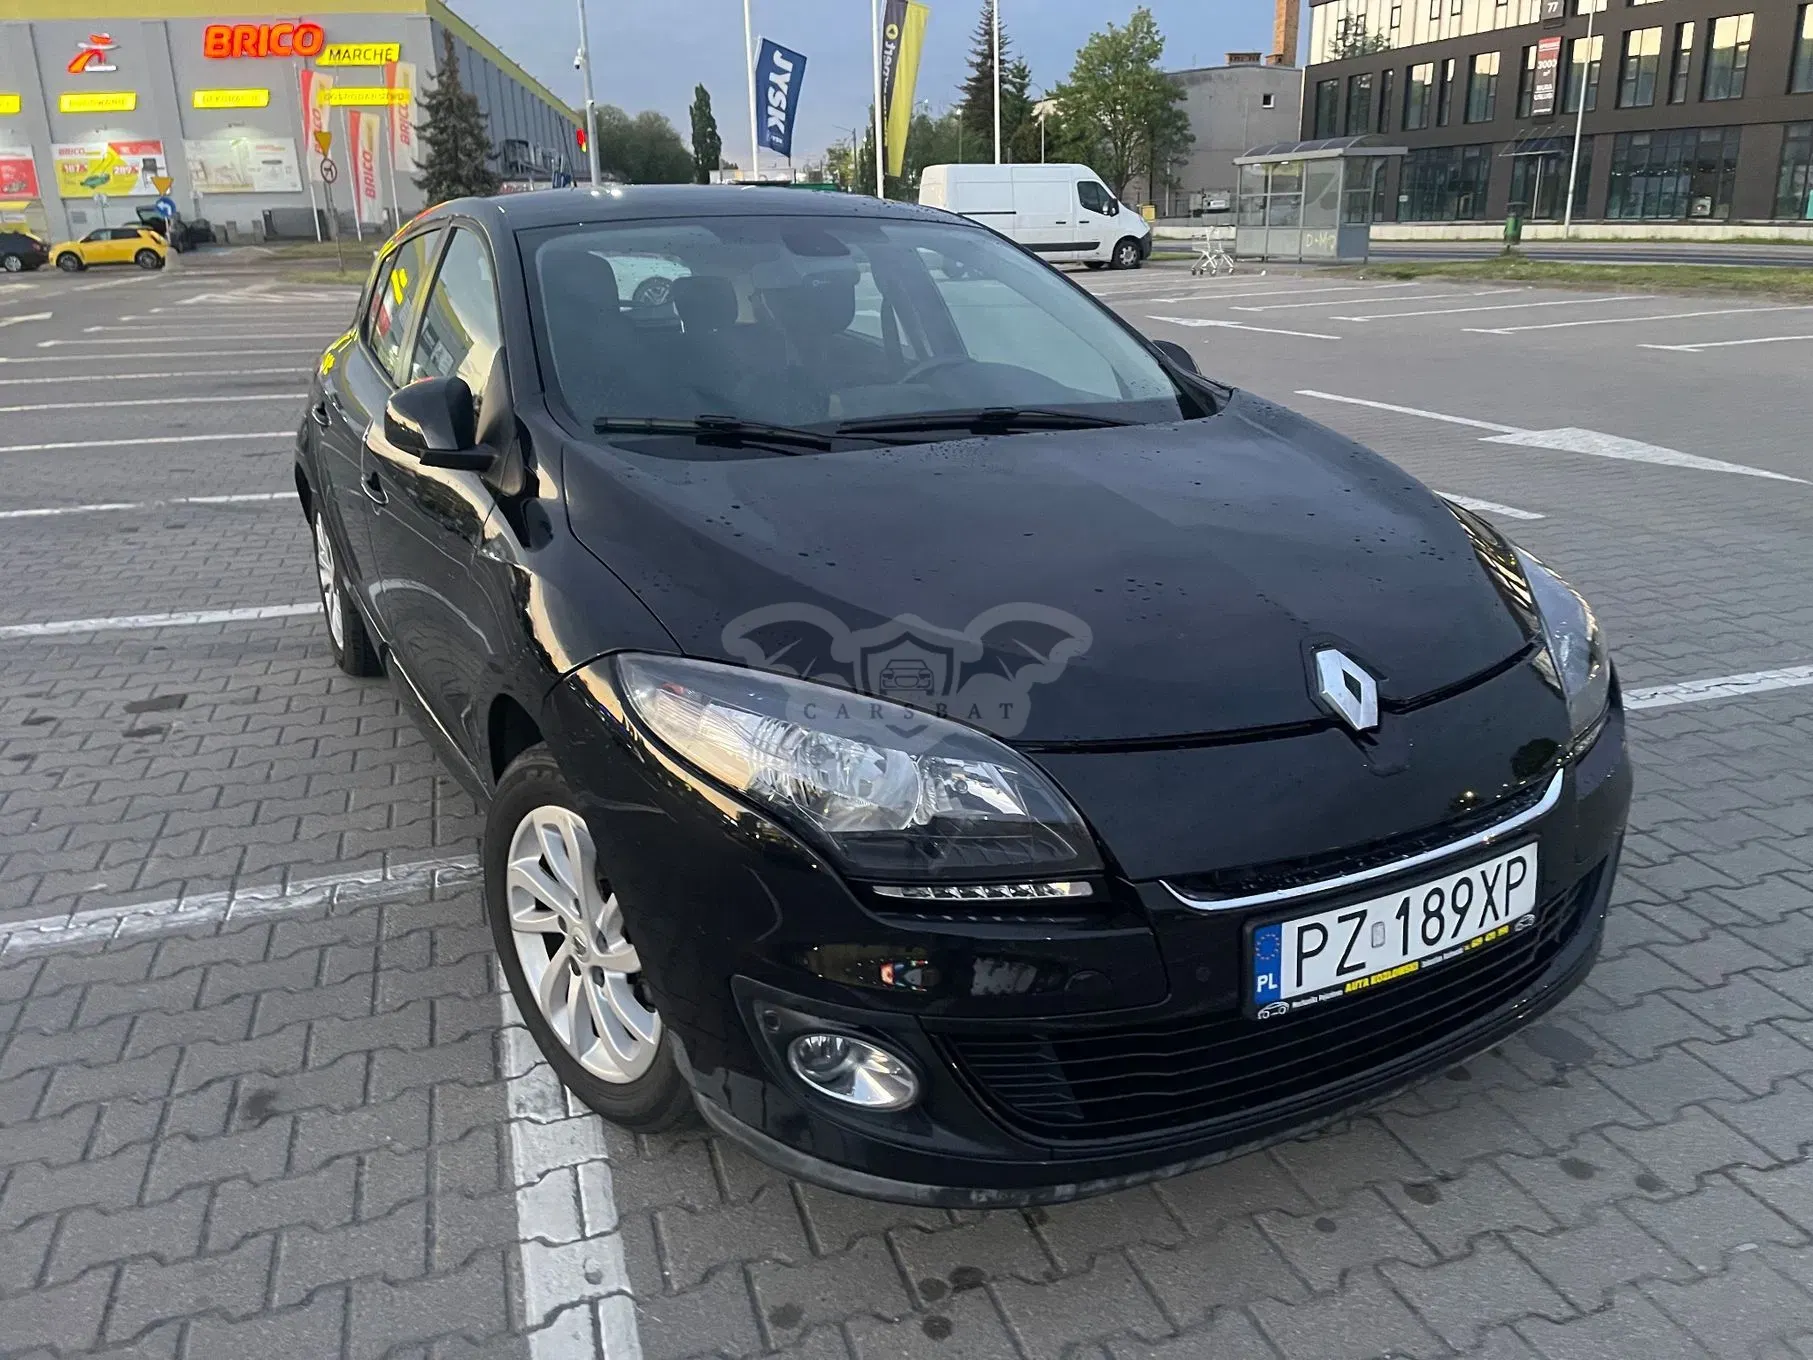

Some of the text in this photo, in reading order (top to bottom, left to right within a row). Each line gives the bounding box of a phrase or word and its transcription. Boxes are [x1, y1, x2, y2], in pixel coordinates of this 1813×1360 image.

[1547, 1, 1559, 13] 77
[203, 23, 325, 59] BRICO
[328, 46, 393, 62] MARCHÉ
[768, 50, 793, 134] JYSK
[362, 150, 377, 199] BRICO
[1296, 855, 1528, 988] PZ 189XP
[1256, 973, 1278, 993] PL
